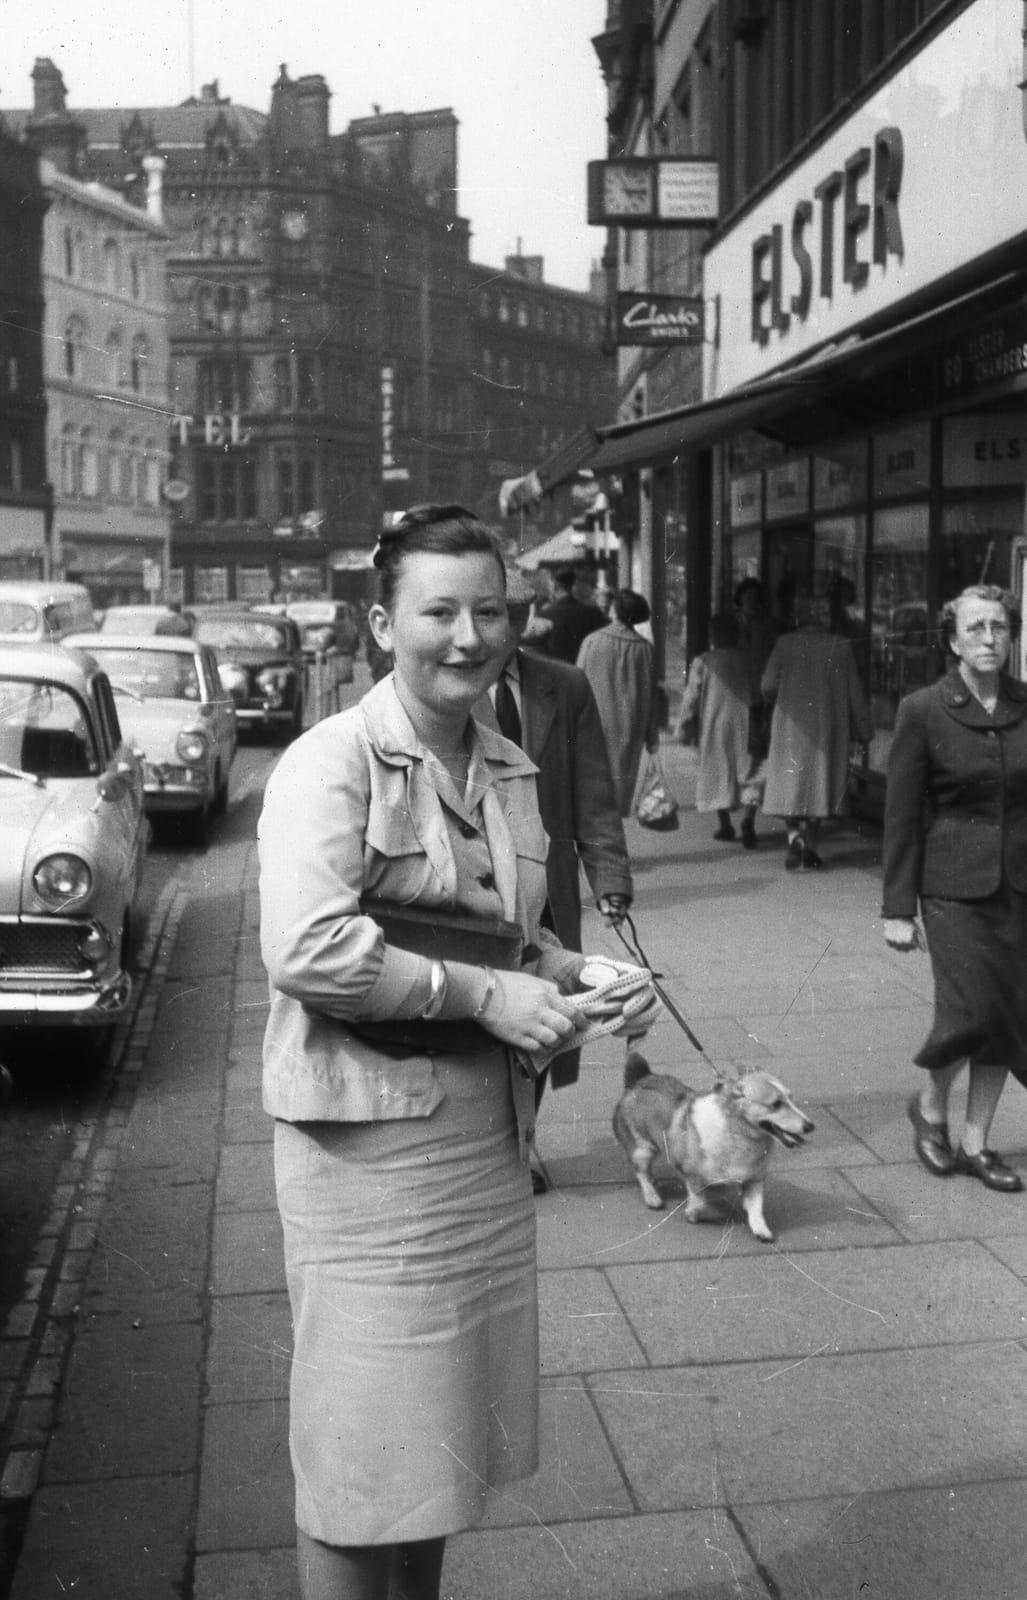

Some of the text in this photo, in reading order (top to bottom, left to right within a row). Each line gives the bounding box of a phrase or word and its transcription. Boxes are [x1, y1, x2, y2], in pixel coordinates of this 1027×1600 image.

[752, 127, 904, 349] ELSTER
[623, 302, 698, 327] Clarks
[975, 438, 1024, 461] ELS
